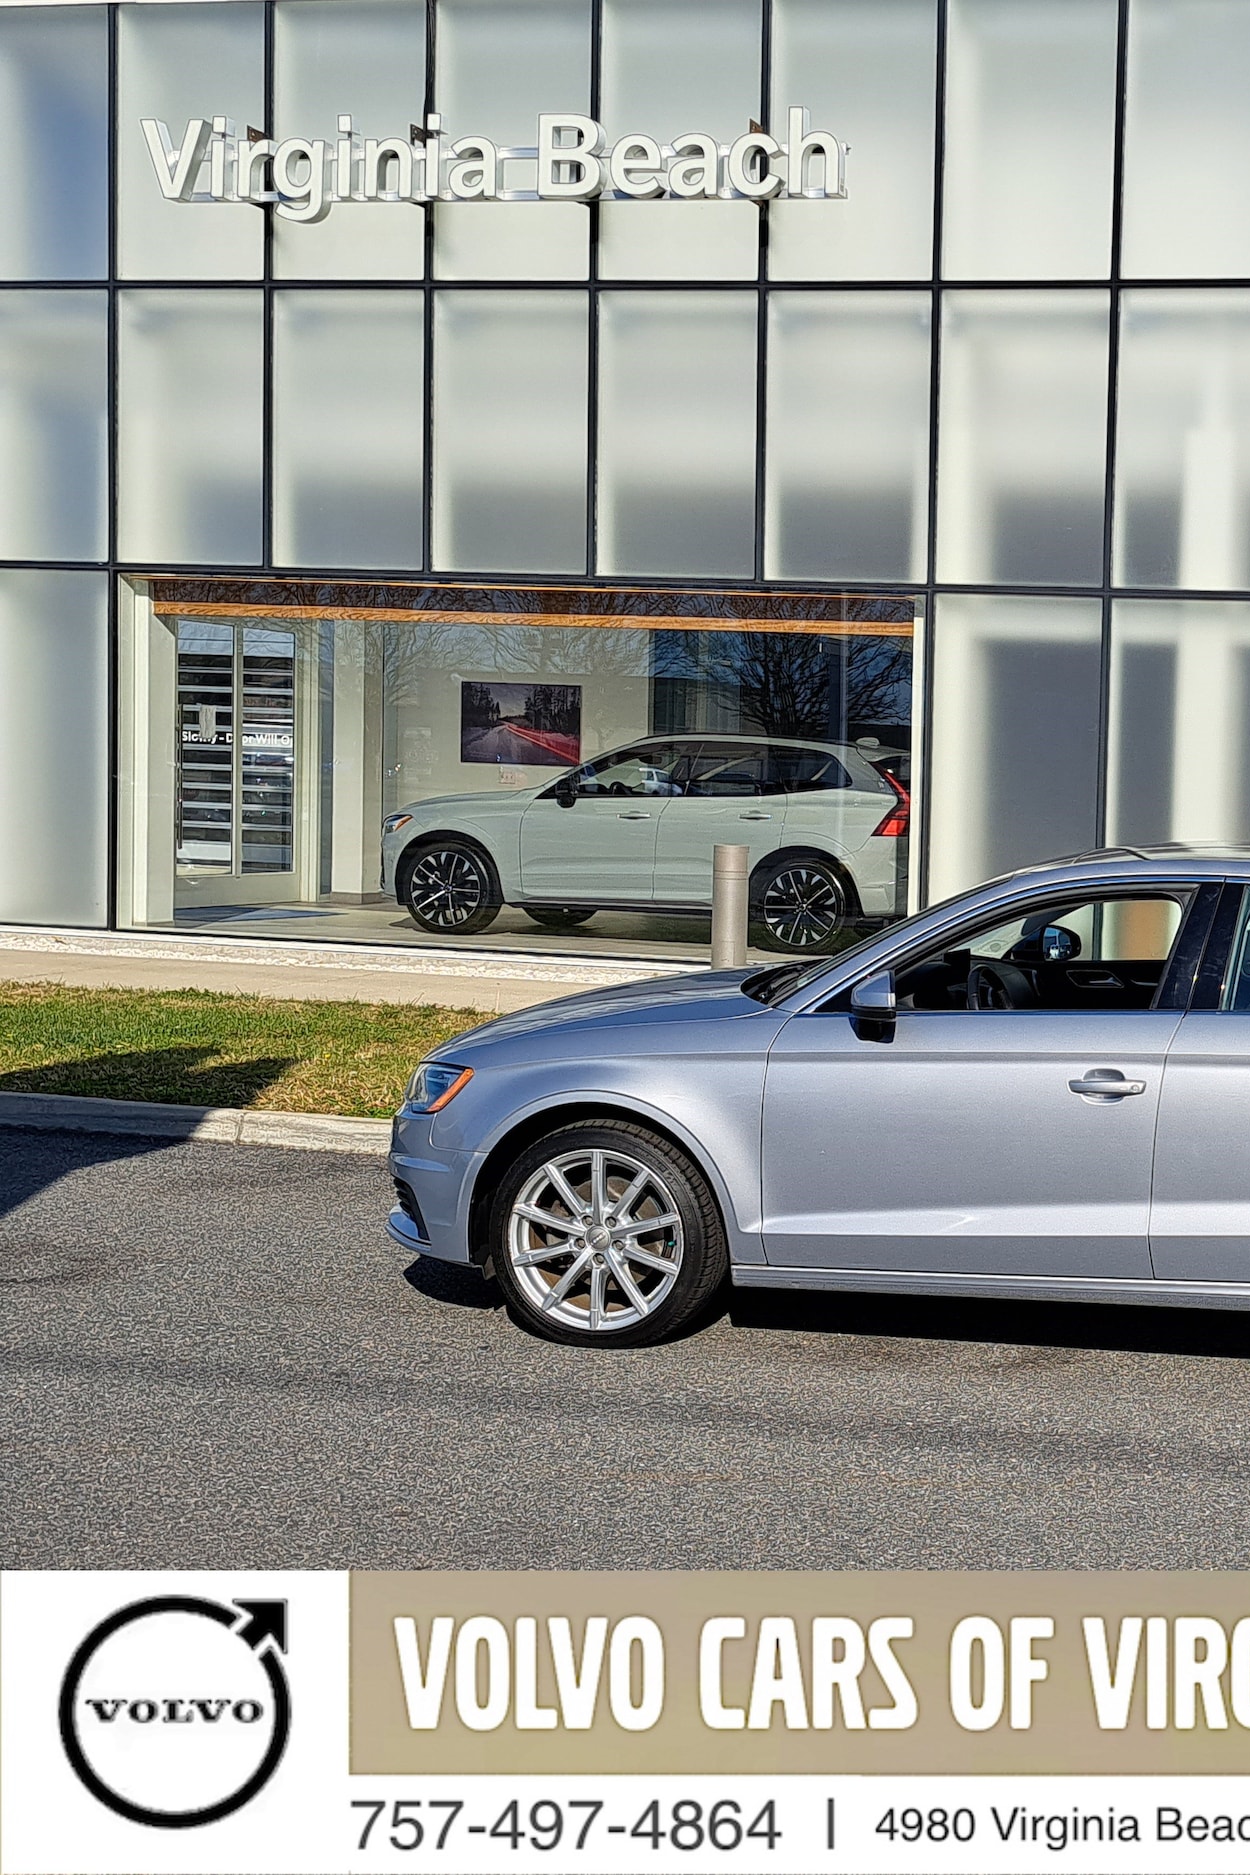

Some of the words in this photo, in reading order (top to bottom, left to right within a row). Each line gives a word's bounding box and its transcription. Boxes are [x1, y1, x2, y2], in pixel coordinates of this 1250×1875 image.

[140, 113, 498, 222] Virginia
[537, 105, 844, 199] Beach
[255, 733, 278, 745] Will
